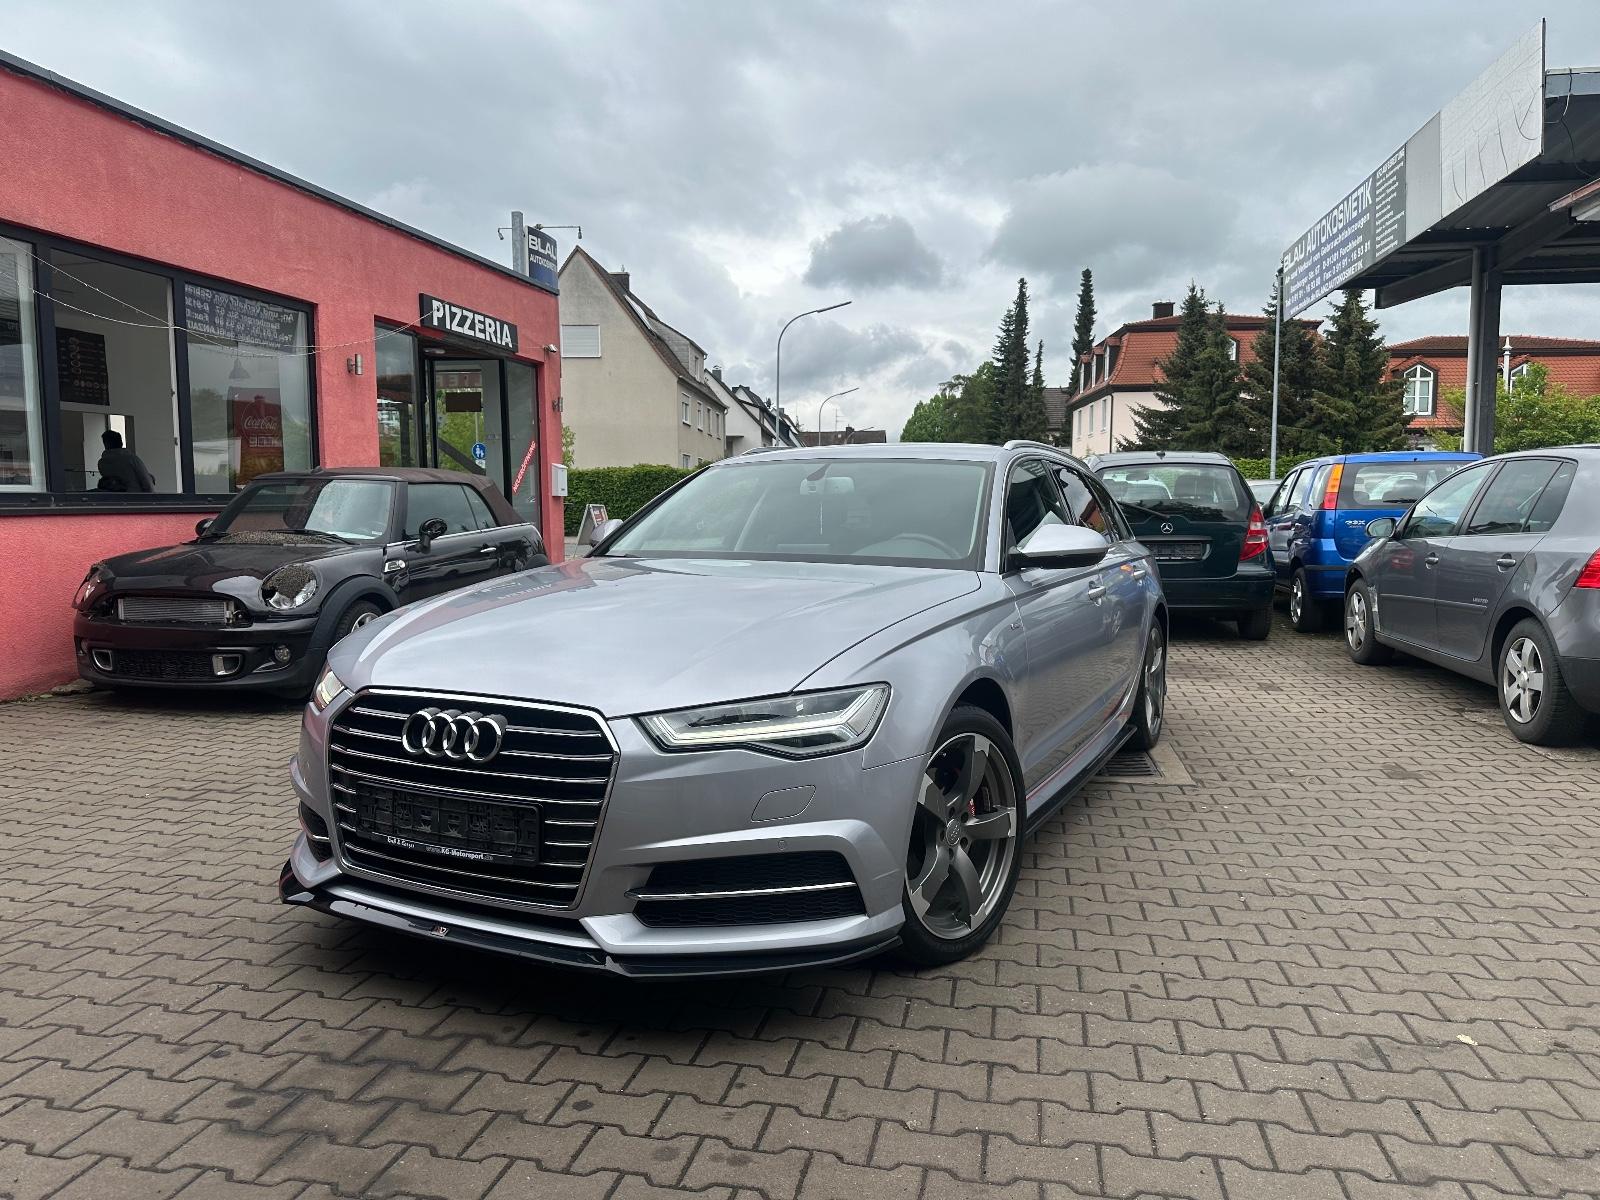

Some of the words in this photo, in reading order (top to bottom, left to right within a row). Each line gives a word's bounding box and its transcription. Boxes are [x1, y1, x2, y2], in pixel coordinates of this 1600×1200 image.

[1283, 240, 1305, 273] BLAU
[1306, 177, 1372, 256] AUTOKOSMETIK
[431, 299, 513, 348] PIZZERIA
